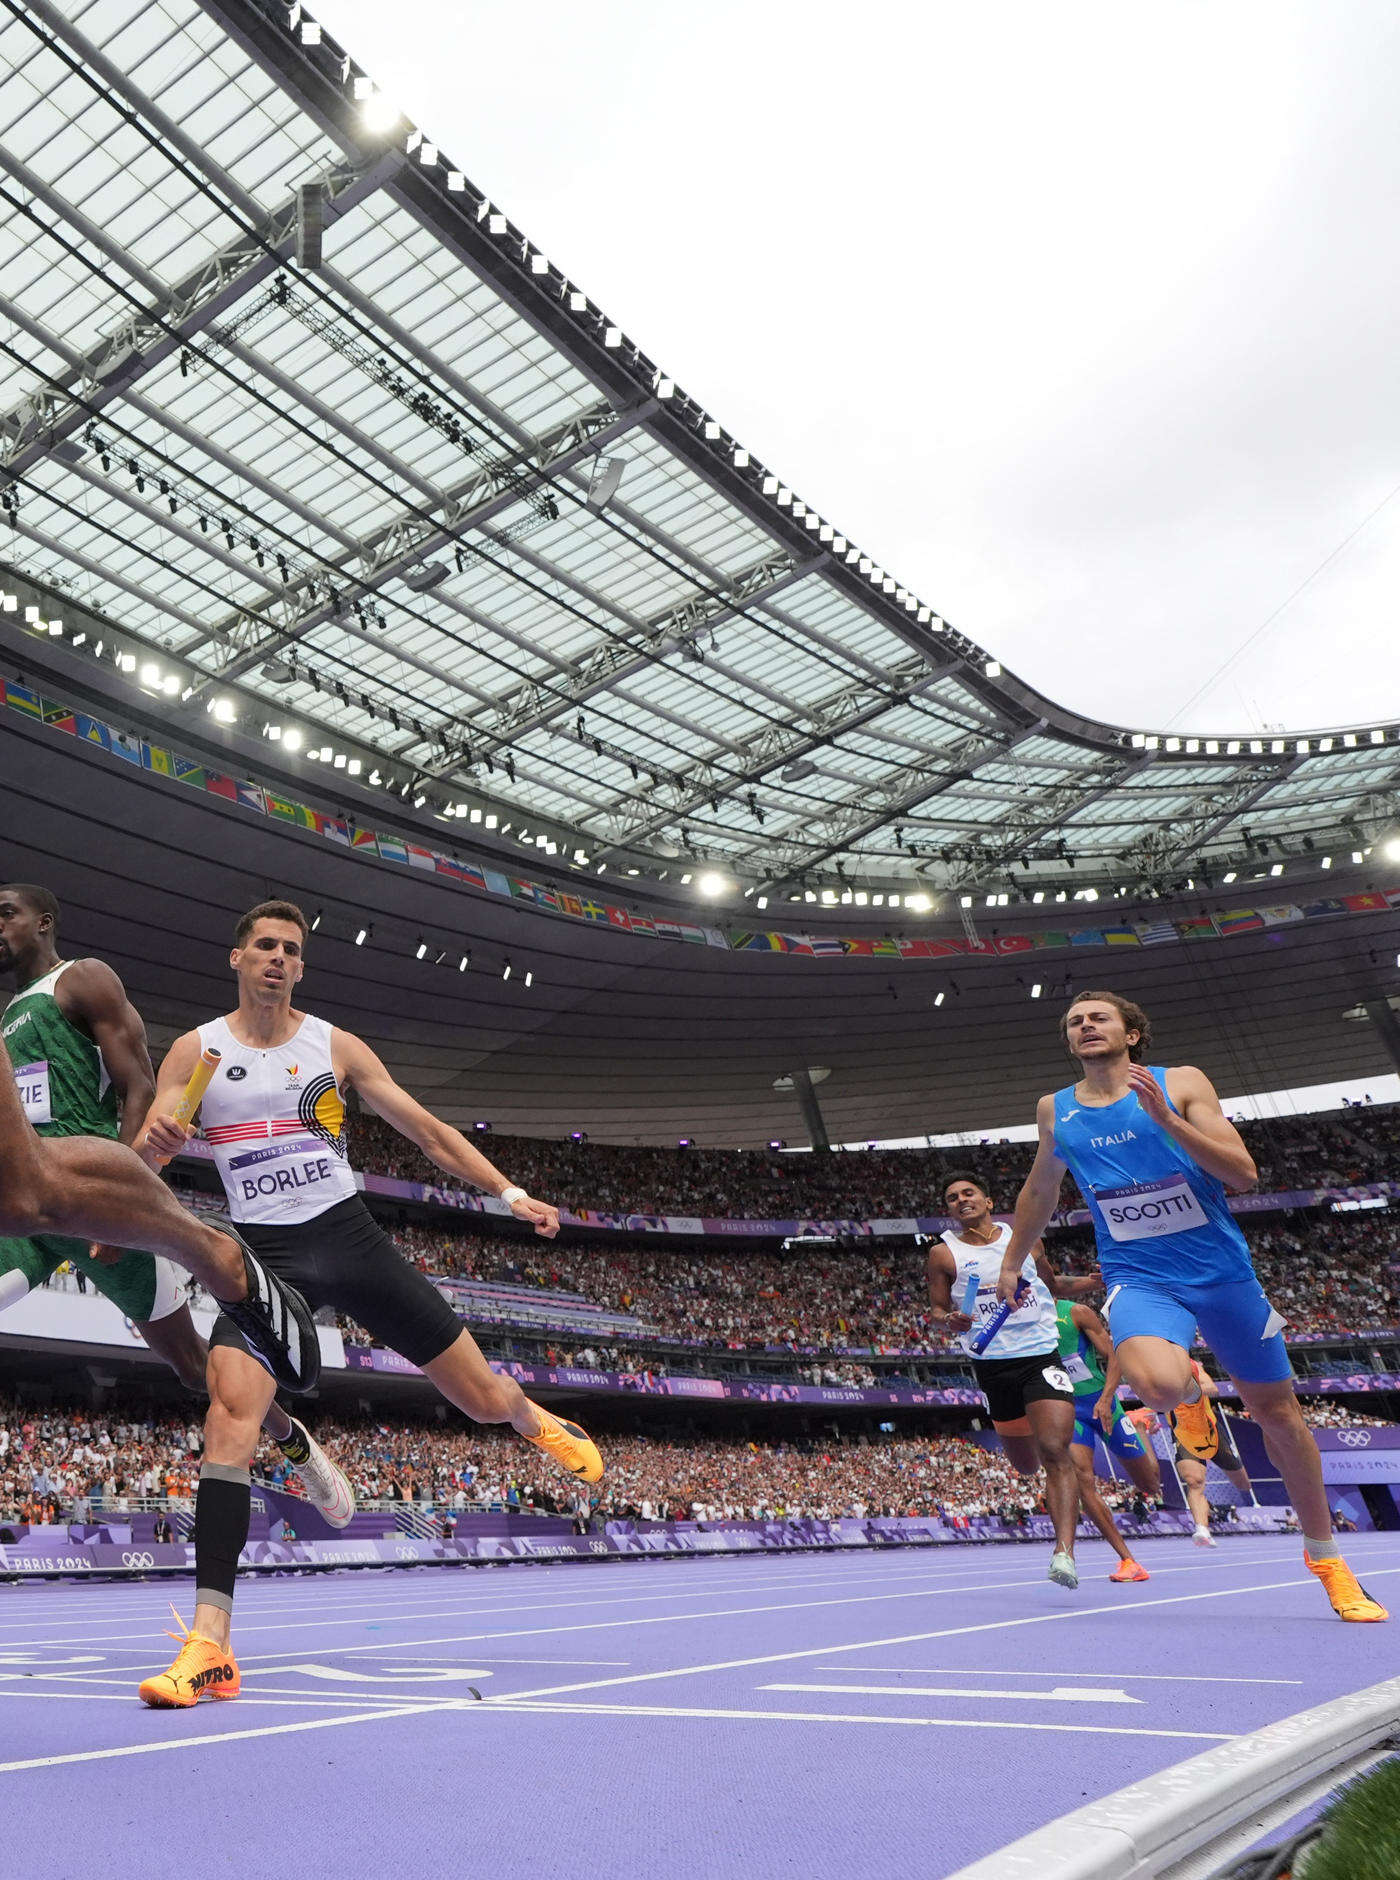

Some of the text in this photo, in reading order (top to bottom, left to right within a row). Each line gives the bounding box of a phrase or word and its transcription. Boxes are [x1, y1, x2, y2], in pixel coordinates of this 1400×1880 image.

[1090, 1129, 1137, 1149] ITALIA
[251, 1144, 302, 1161] PARIS 2024
[242, 1158, 332, 1201] BORLEE
[1115, 1183, 1162, 1197] PARIS 2024
[1109, 1194, 1193, 1224] SCOTTI
[979, 1295, 1038, 1315] RASH
[982, 1313, 1000, 1335] PARIS
[566, 1372, 589, 1384] PARIS
[590, 1374, 609, 1385] 2024
[1053, 1373, 1066, 1386] 2
[822, 1390, 844, 1400] PARIS
[14, 1556, 91, 1571] PARIS 2024
[188, 1663, 234, 1698] NITRO
